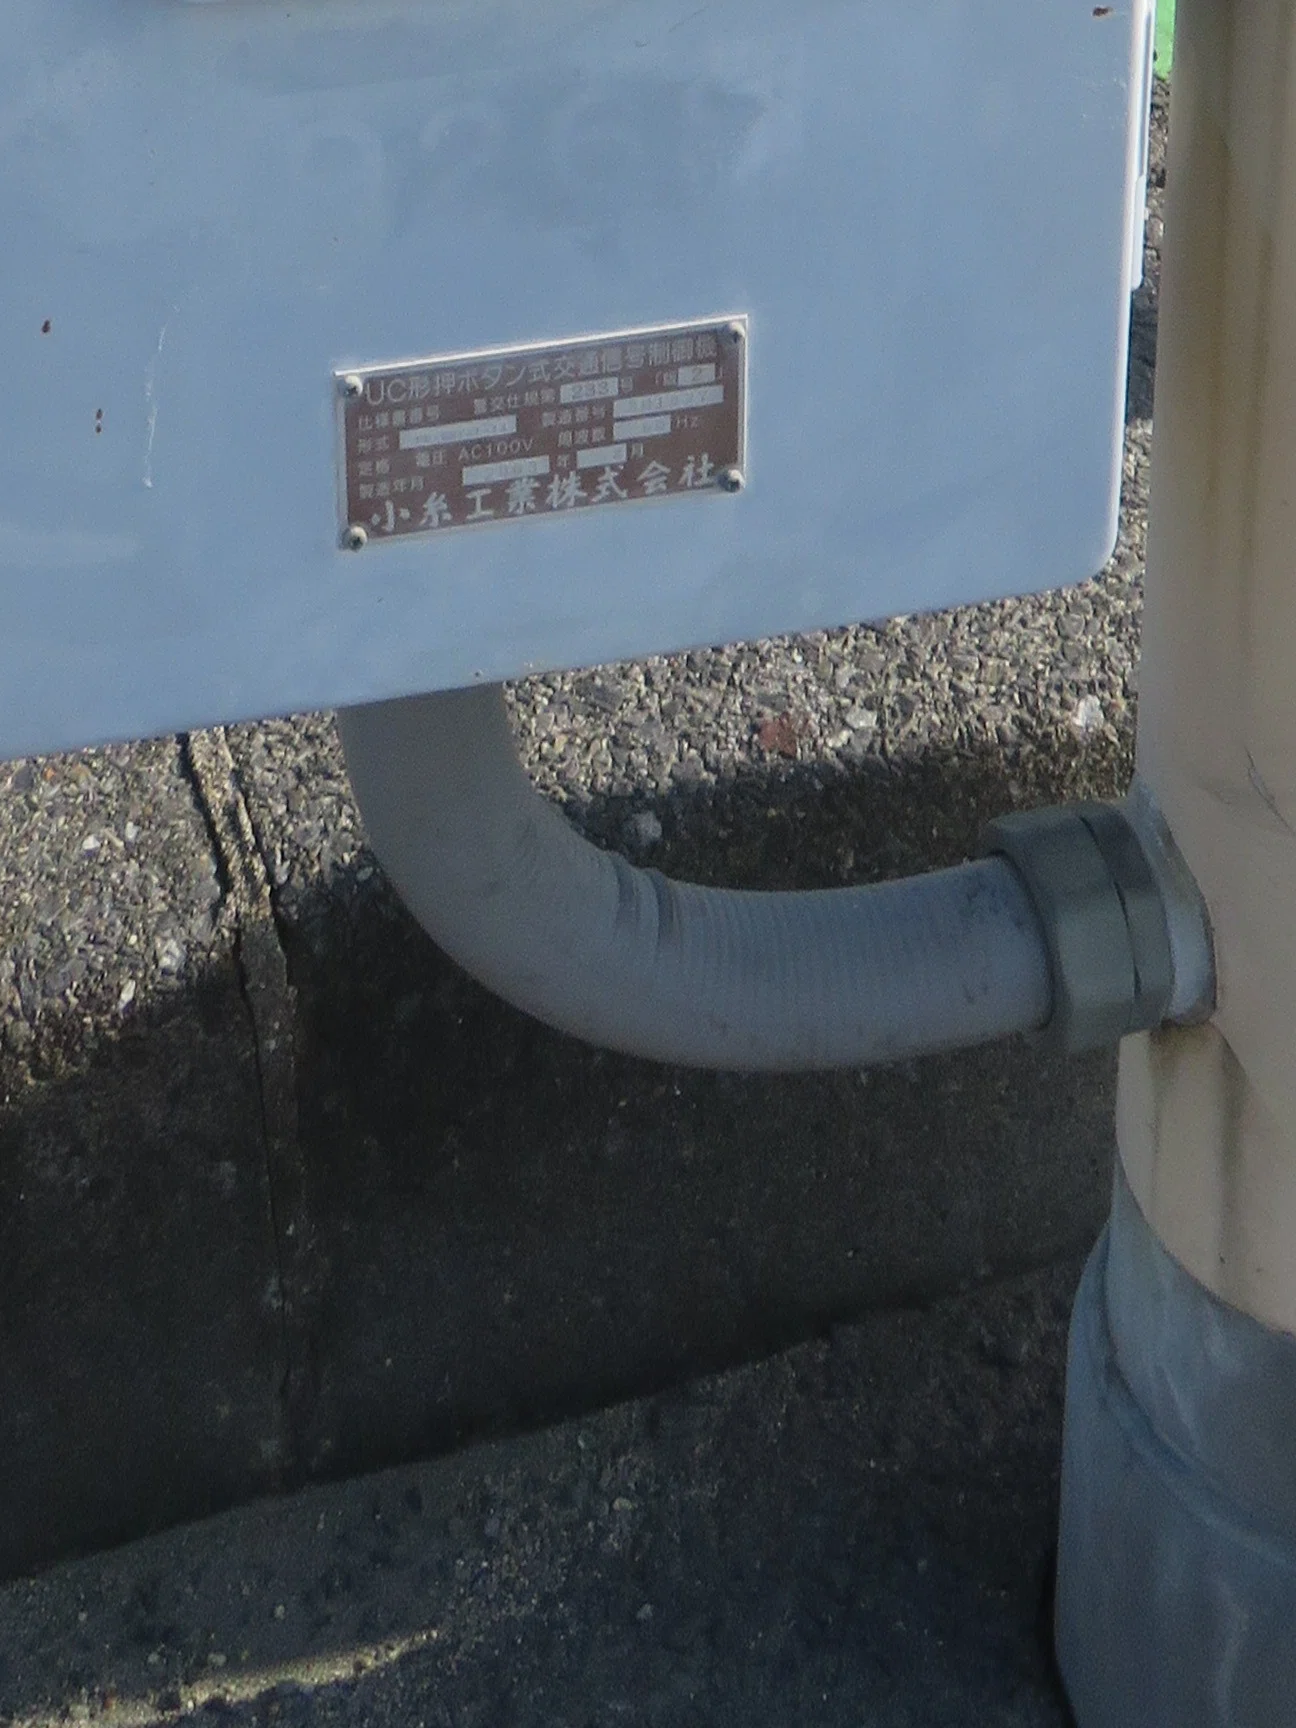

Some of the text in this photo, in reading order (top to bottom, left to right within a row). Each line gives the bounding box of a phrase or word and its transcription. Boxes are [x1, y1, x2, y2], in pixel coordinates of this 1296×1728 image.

[457, 436, 534, 462] AC100V
[370, 452, 716, 532] 小糸工業株式会社
